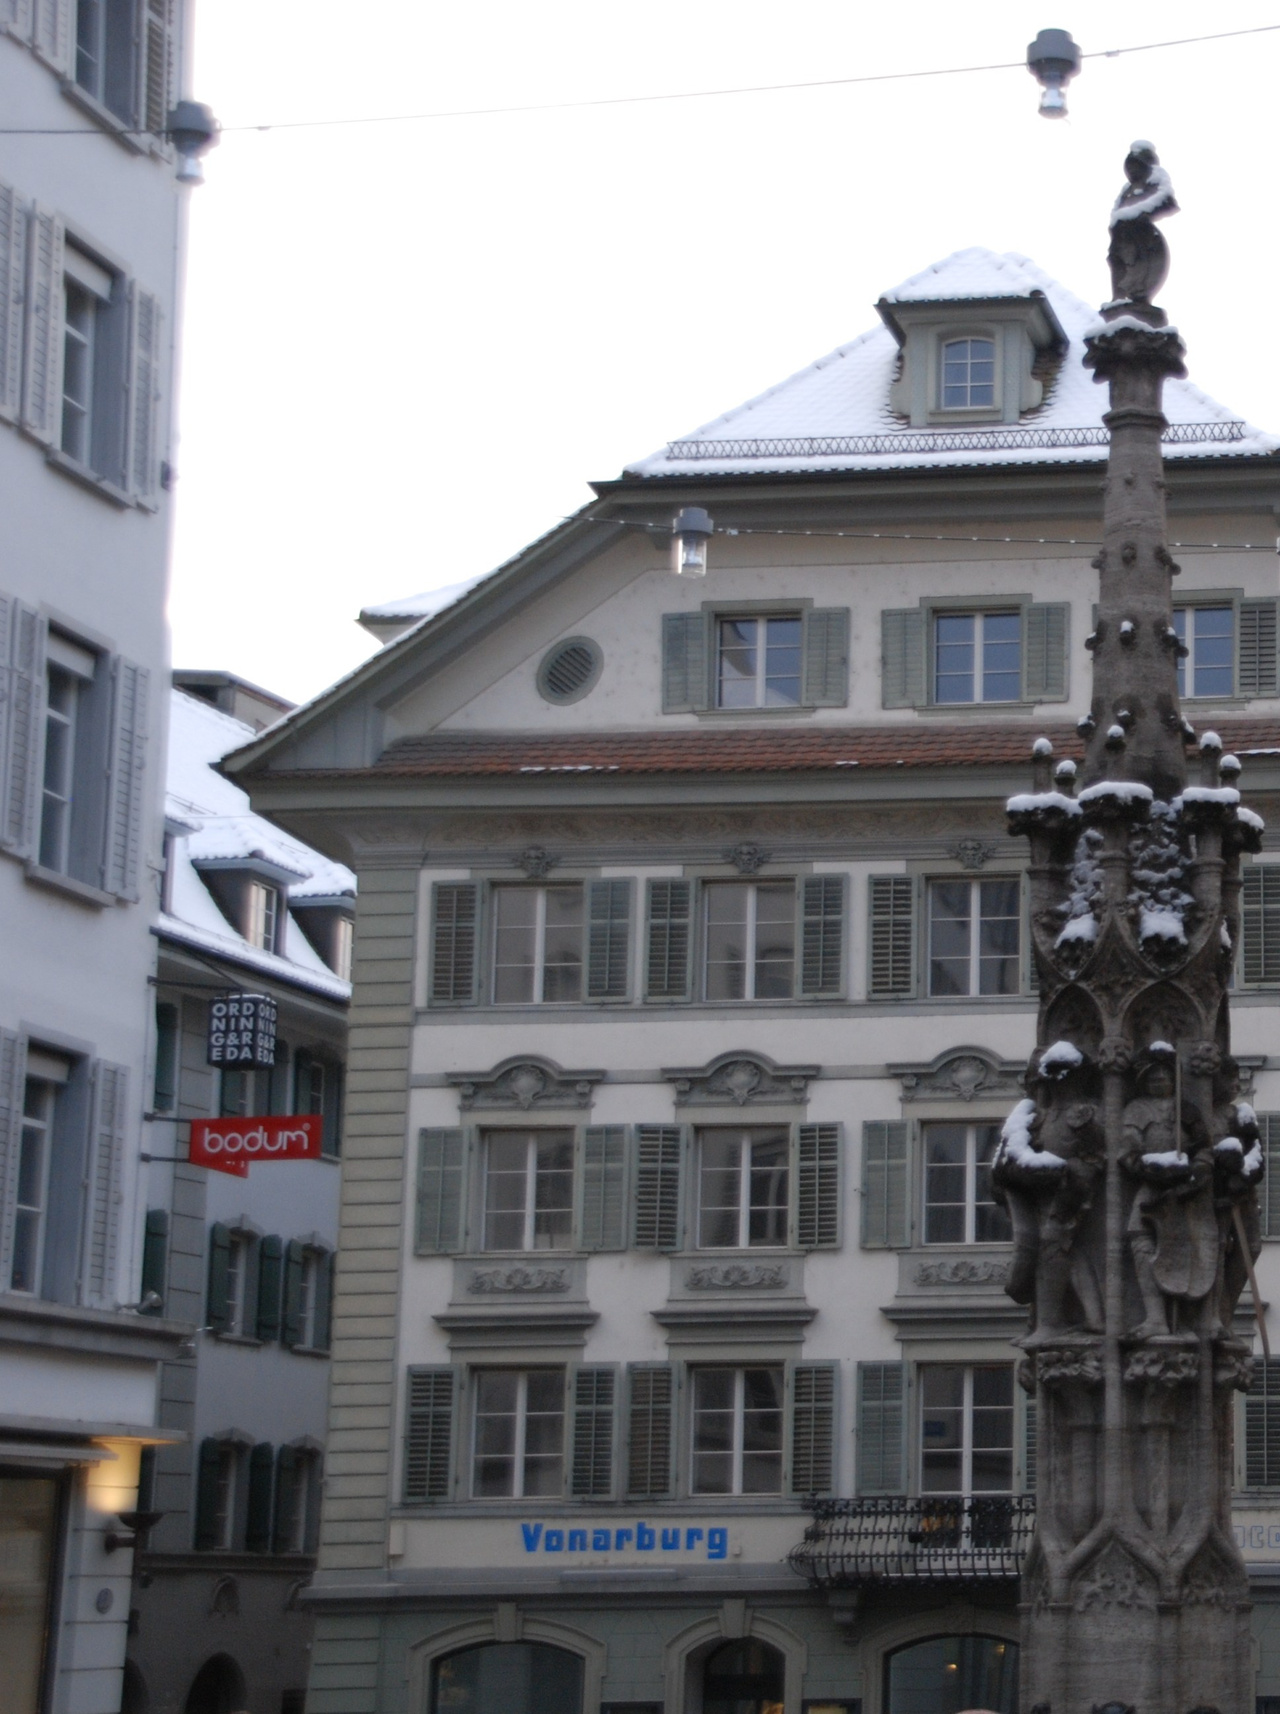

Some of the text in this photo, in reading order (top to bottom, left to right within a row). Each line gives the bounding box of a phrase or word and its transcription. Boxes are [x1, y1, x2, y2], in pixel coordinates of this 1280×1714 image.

[212, 1002, 255, 1017] ORD
[257, 1004, 277, 1020] ORD
[211, 1017, 254, 1032] NIN
[257, 1018, 276, 1035] NIN
[210, 1032, 253, 1046] G&R
[256, 1032, 275, 1049] G&R
[211, 1047, 253, 1061] EDA
[256, 1047, 275, 1066] EDA
[521, 1521, 728, 1559] Vonarburg
